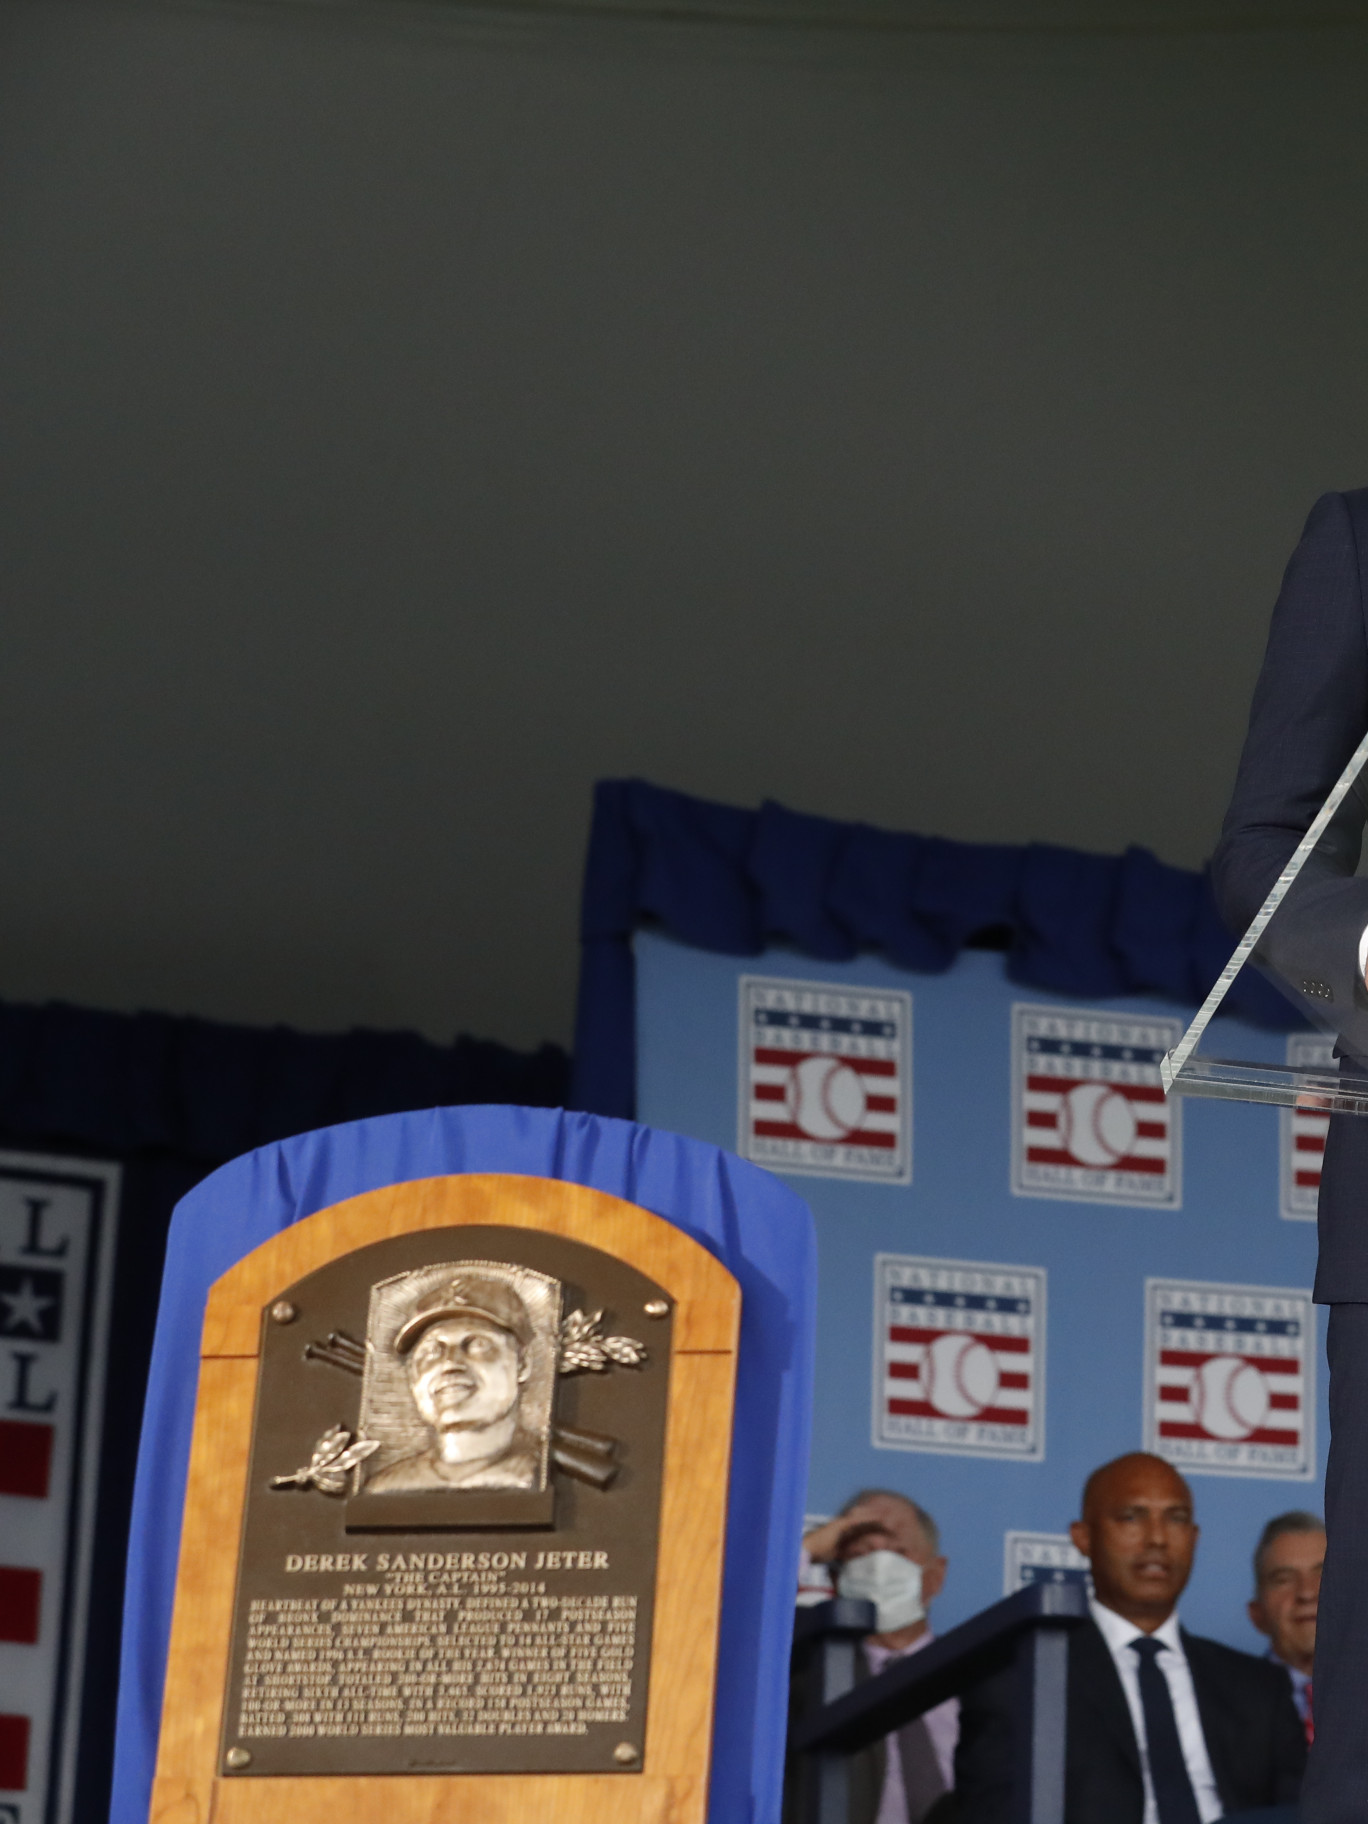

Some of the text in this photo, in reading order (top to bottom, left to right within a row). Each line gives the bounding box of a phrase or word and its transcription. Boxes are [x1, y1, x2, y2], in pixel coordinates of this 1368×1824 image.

[286, 1551, 610, 1572] DEREK SANDERSON JETER
[344, 1581, 546, 1597] NEW YORK, A.L. 1995-2014
